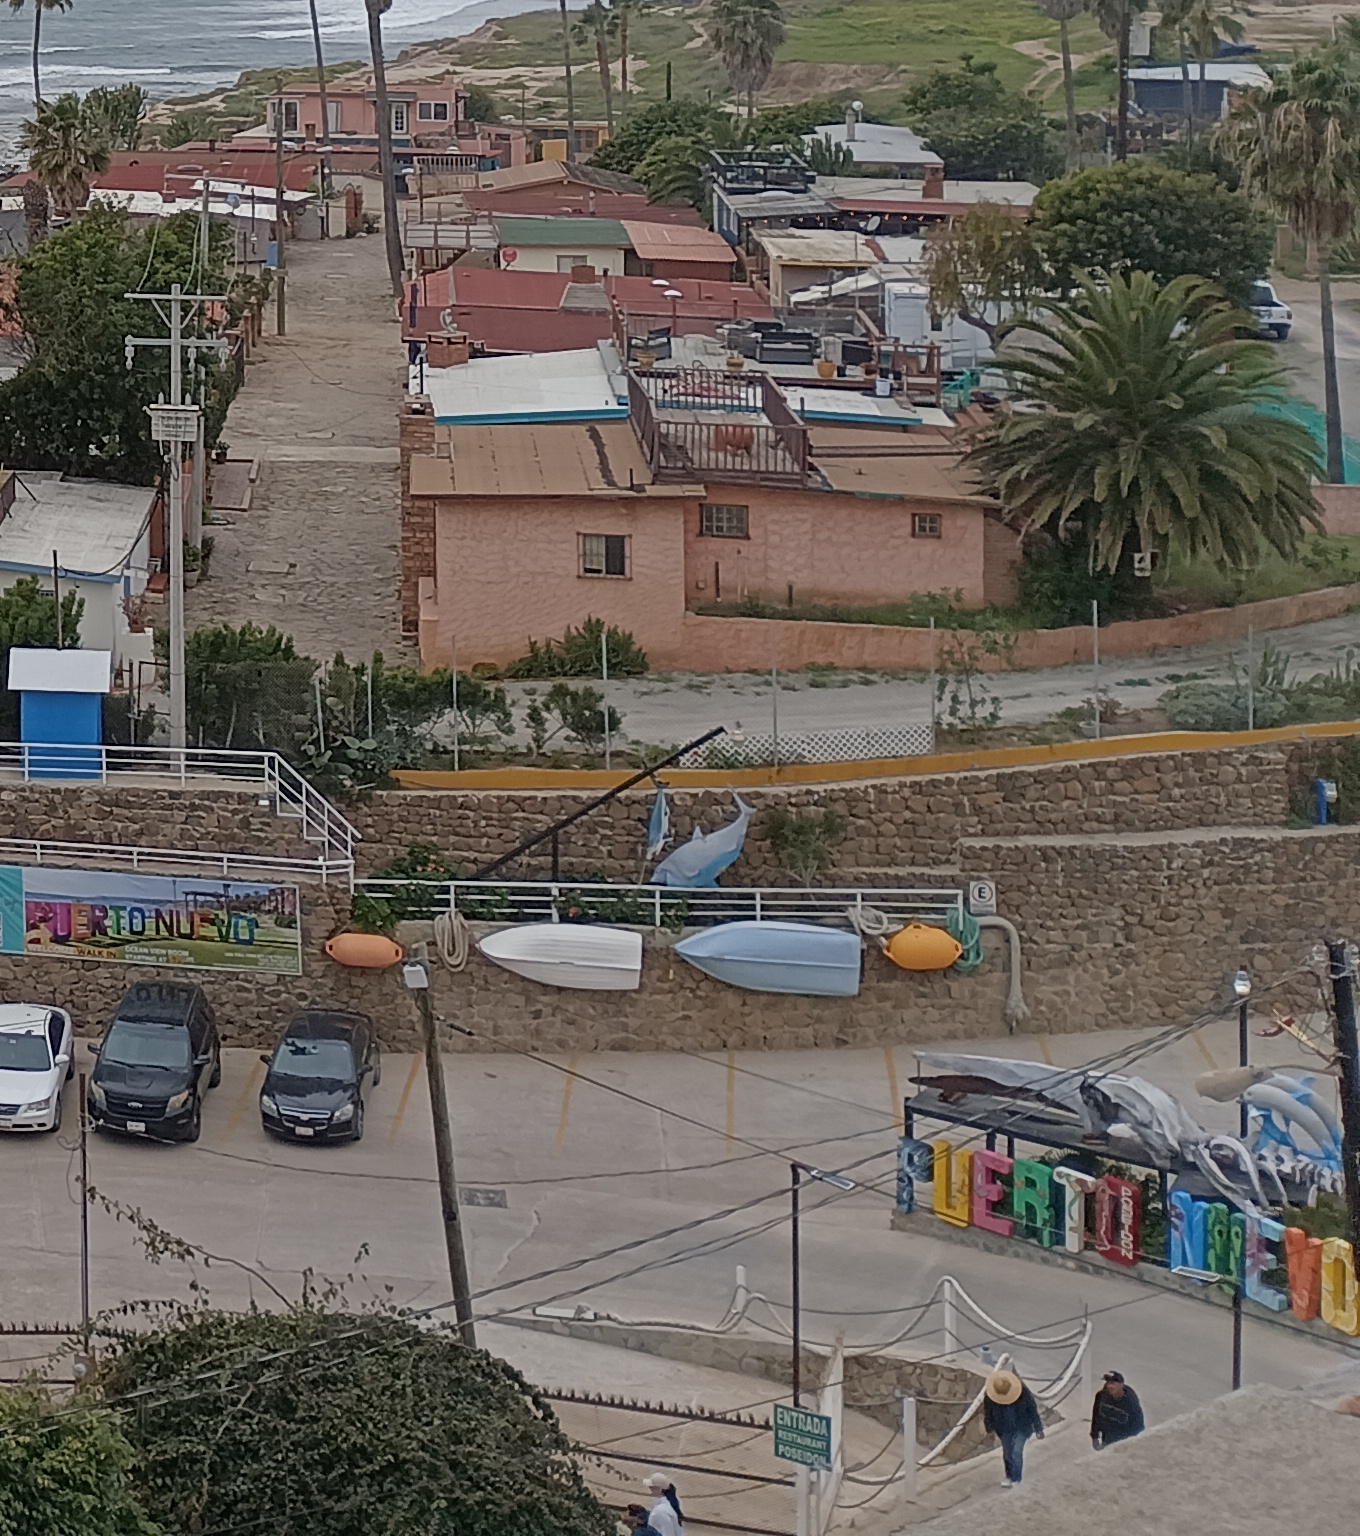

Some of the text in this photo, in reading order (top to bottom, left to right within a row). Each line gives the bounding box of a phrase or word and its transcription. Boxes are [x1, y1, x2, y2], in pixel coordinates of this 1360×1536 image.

[978, 886, 986, 899] E
[26, 901, 258, 945] PUERTO NUEVO
[77, 947, 105, 957] WALK
[106, 950, 117, 959] IN
[896, 1136, 1360, 1337] PUERTO NUEVO
[776, 1407, 829, 1437] ENTRADA
[778, 1429, 827, 1450] RESTAURANT
[778, 1444, 827, 1466] POSEIDON
